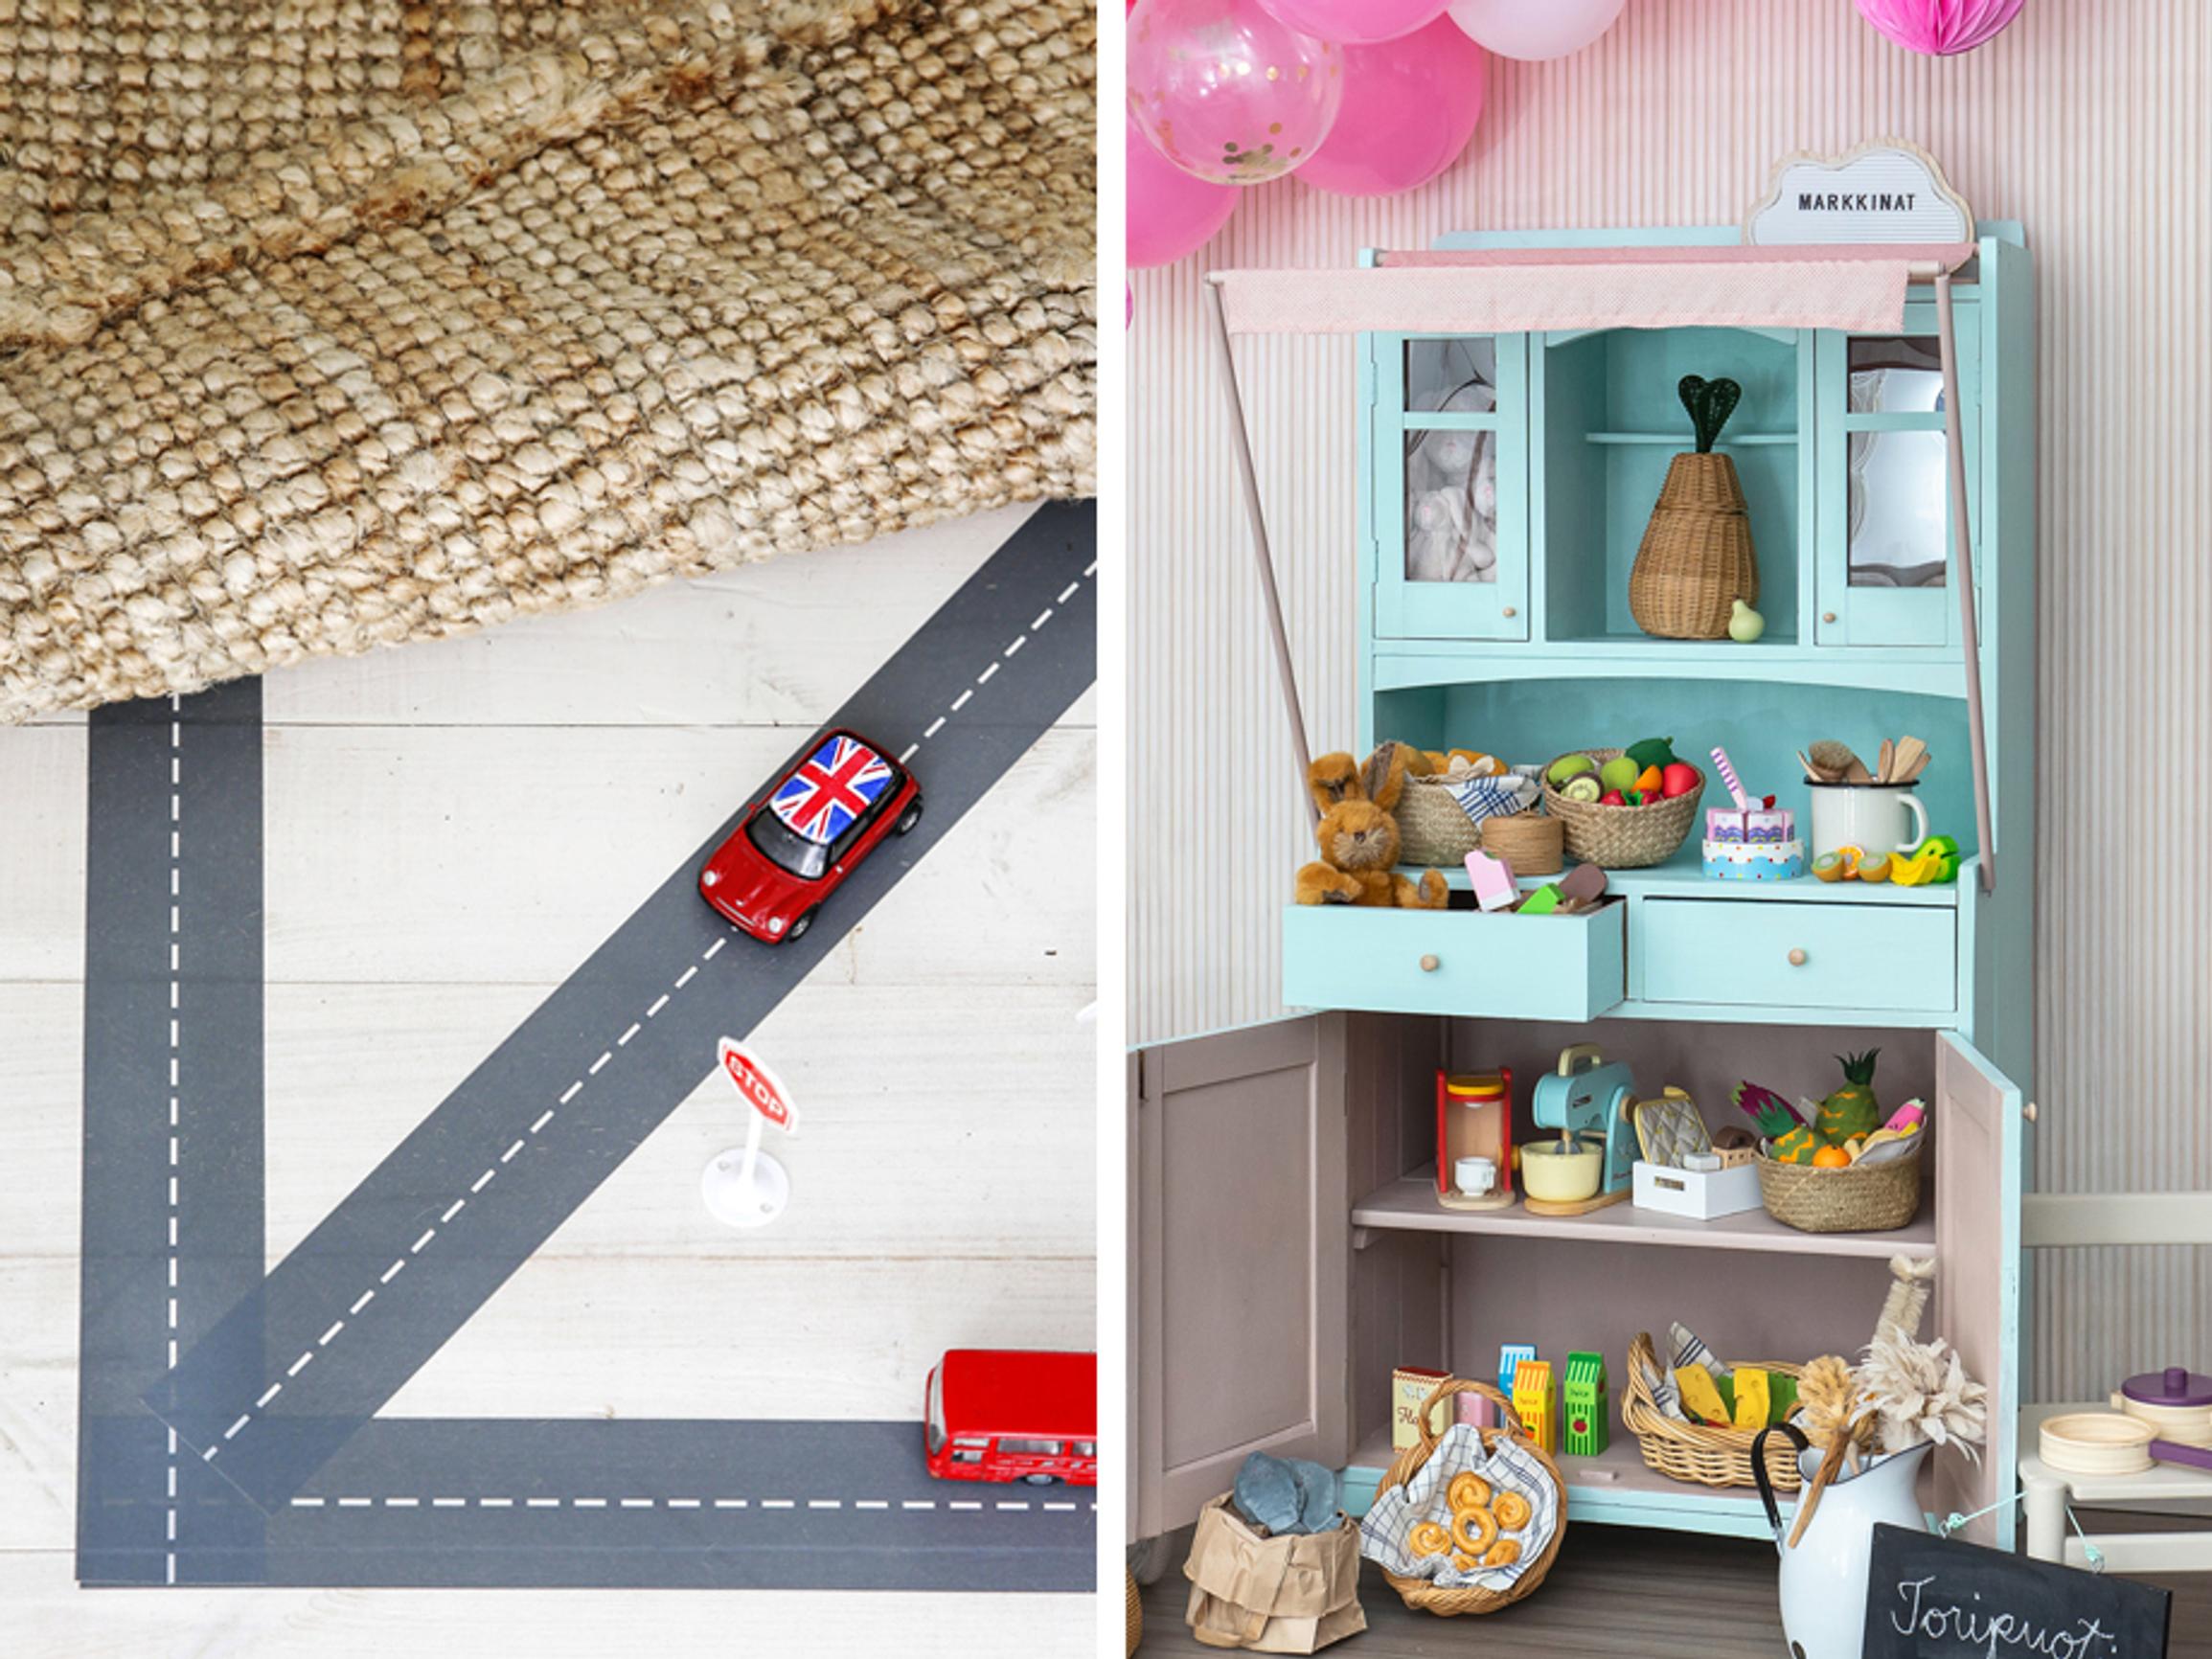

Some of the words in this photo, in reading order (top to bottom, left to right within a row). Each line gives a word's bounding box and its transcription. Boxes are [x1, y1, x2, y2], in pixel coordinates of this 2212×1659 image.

[1798, 193, 1915, 210] MARKKINAT
[729, 1055, 785, 1116] STOP
[1890, 1576, 2118, 1659] Toripuot
